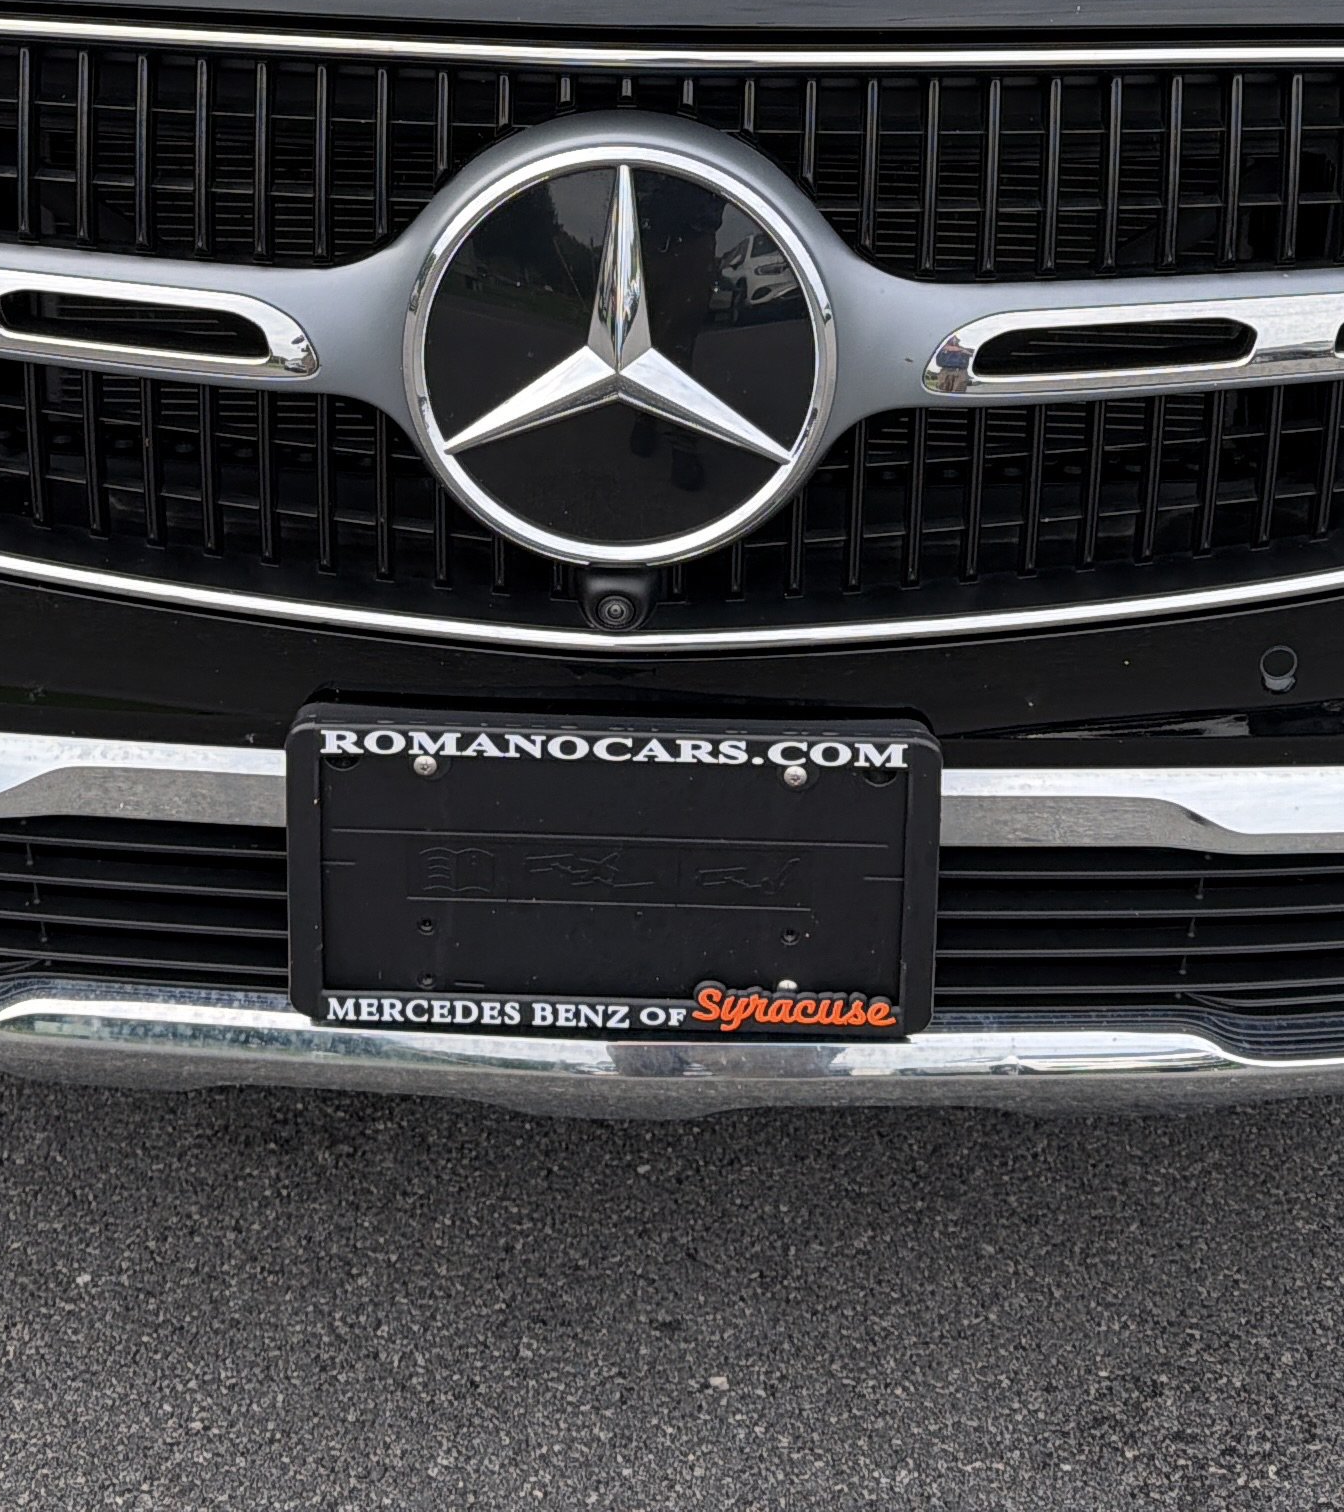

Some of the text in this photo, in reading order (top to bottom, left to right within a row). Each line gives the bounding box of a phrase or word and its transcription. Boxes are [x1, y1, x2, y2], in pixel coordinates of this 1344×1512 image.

[320, 729, 909, 769] ROMANOCARS.COM
[327, 988, 897, 1032] MERCEDES BENZ OF Syracuse
